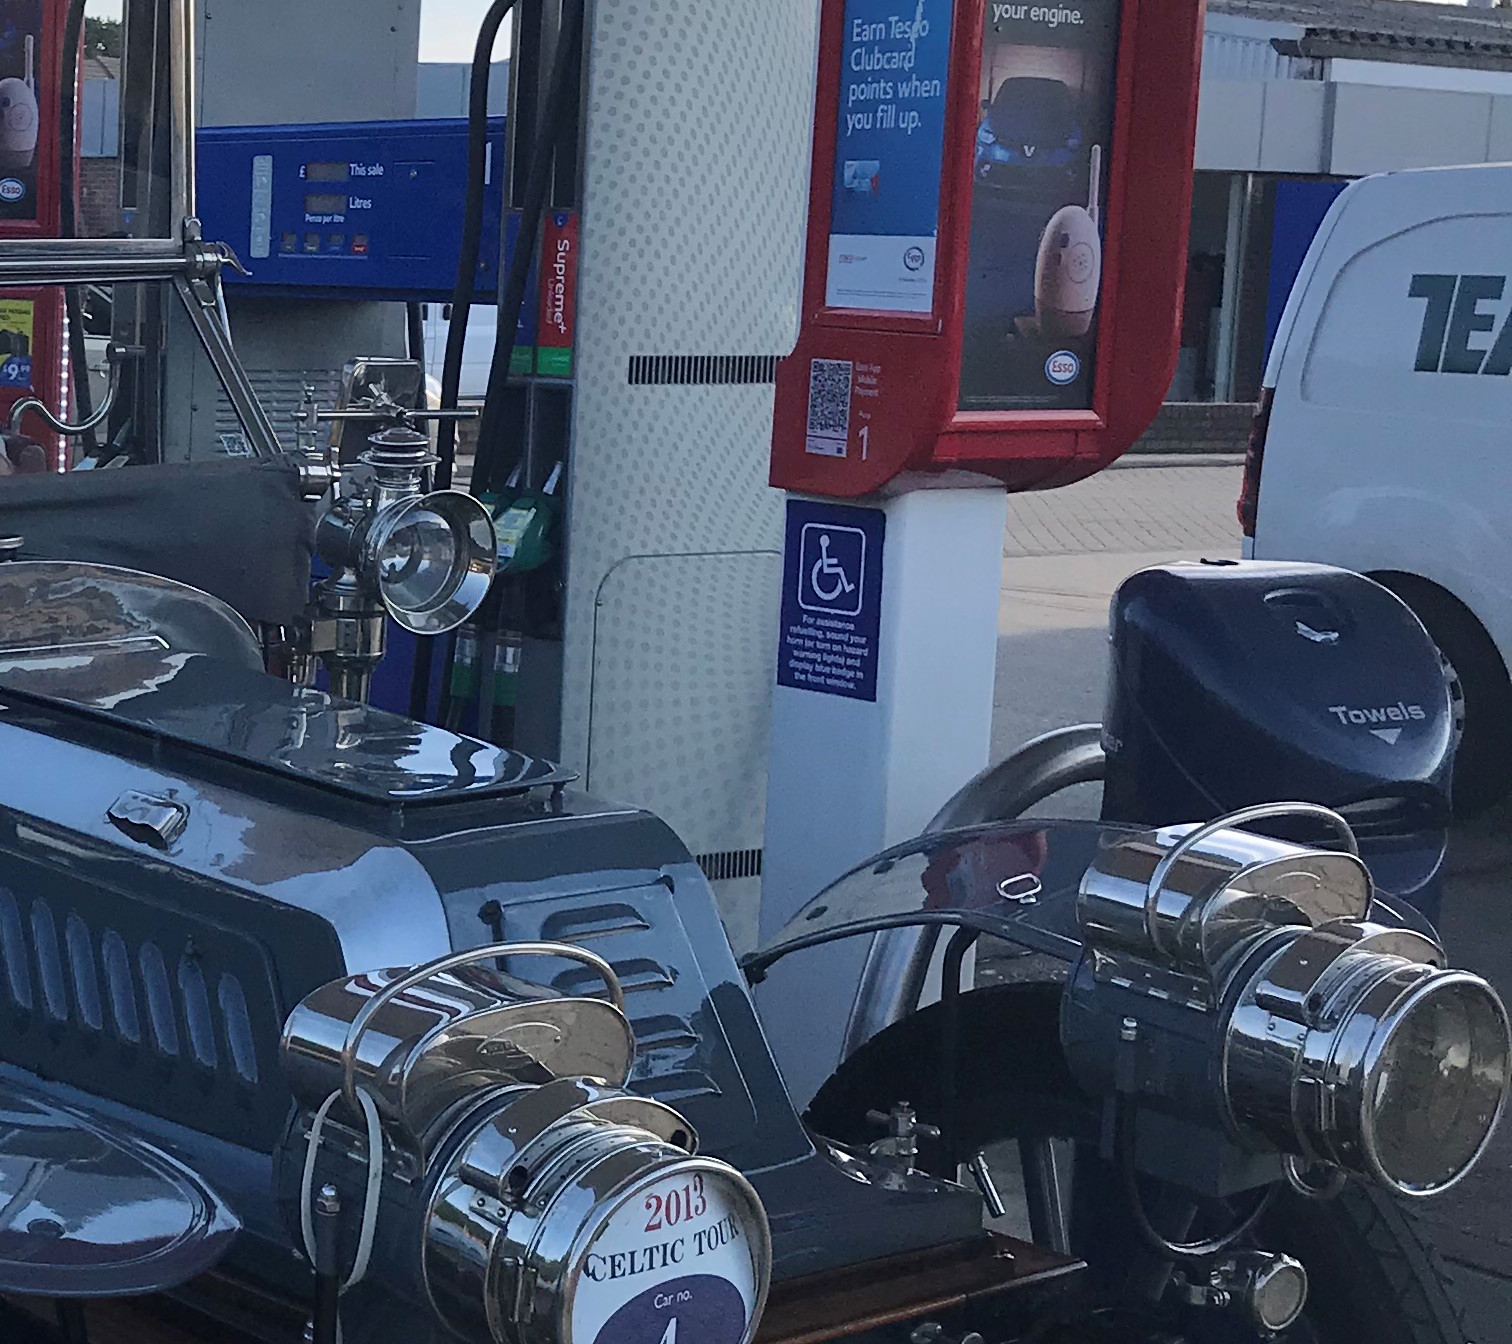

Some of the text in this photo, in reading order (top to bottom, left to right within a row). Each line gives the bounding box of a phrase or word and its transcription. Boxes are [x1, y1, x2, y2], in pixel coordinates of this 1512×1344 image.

[992, 3, 1084, 28] your engine.
[852, 18, 886, 42] Earn
[850, 40, 916, 72] Clubcard
[847, 72, 941, 108] points when
[846, 103, 922, 137] you fill up.
[298, 165, 306, 178] £
[349, 162, 385, 177] This sale
[0, 183, 22, 196] Esso
[348, 196, 372, 209] Litres
[1051, 359, 1074, 374] Esso
[858, 425, 869, 461] 1
[1327, 701, 1426, 725] Towels
[644, 1172, 708, 1233] 2013
[584, 1211, 740, 1282] CELTIC TOUR
[653, 1288, 694, 1310] Car no.
